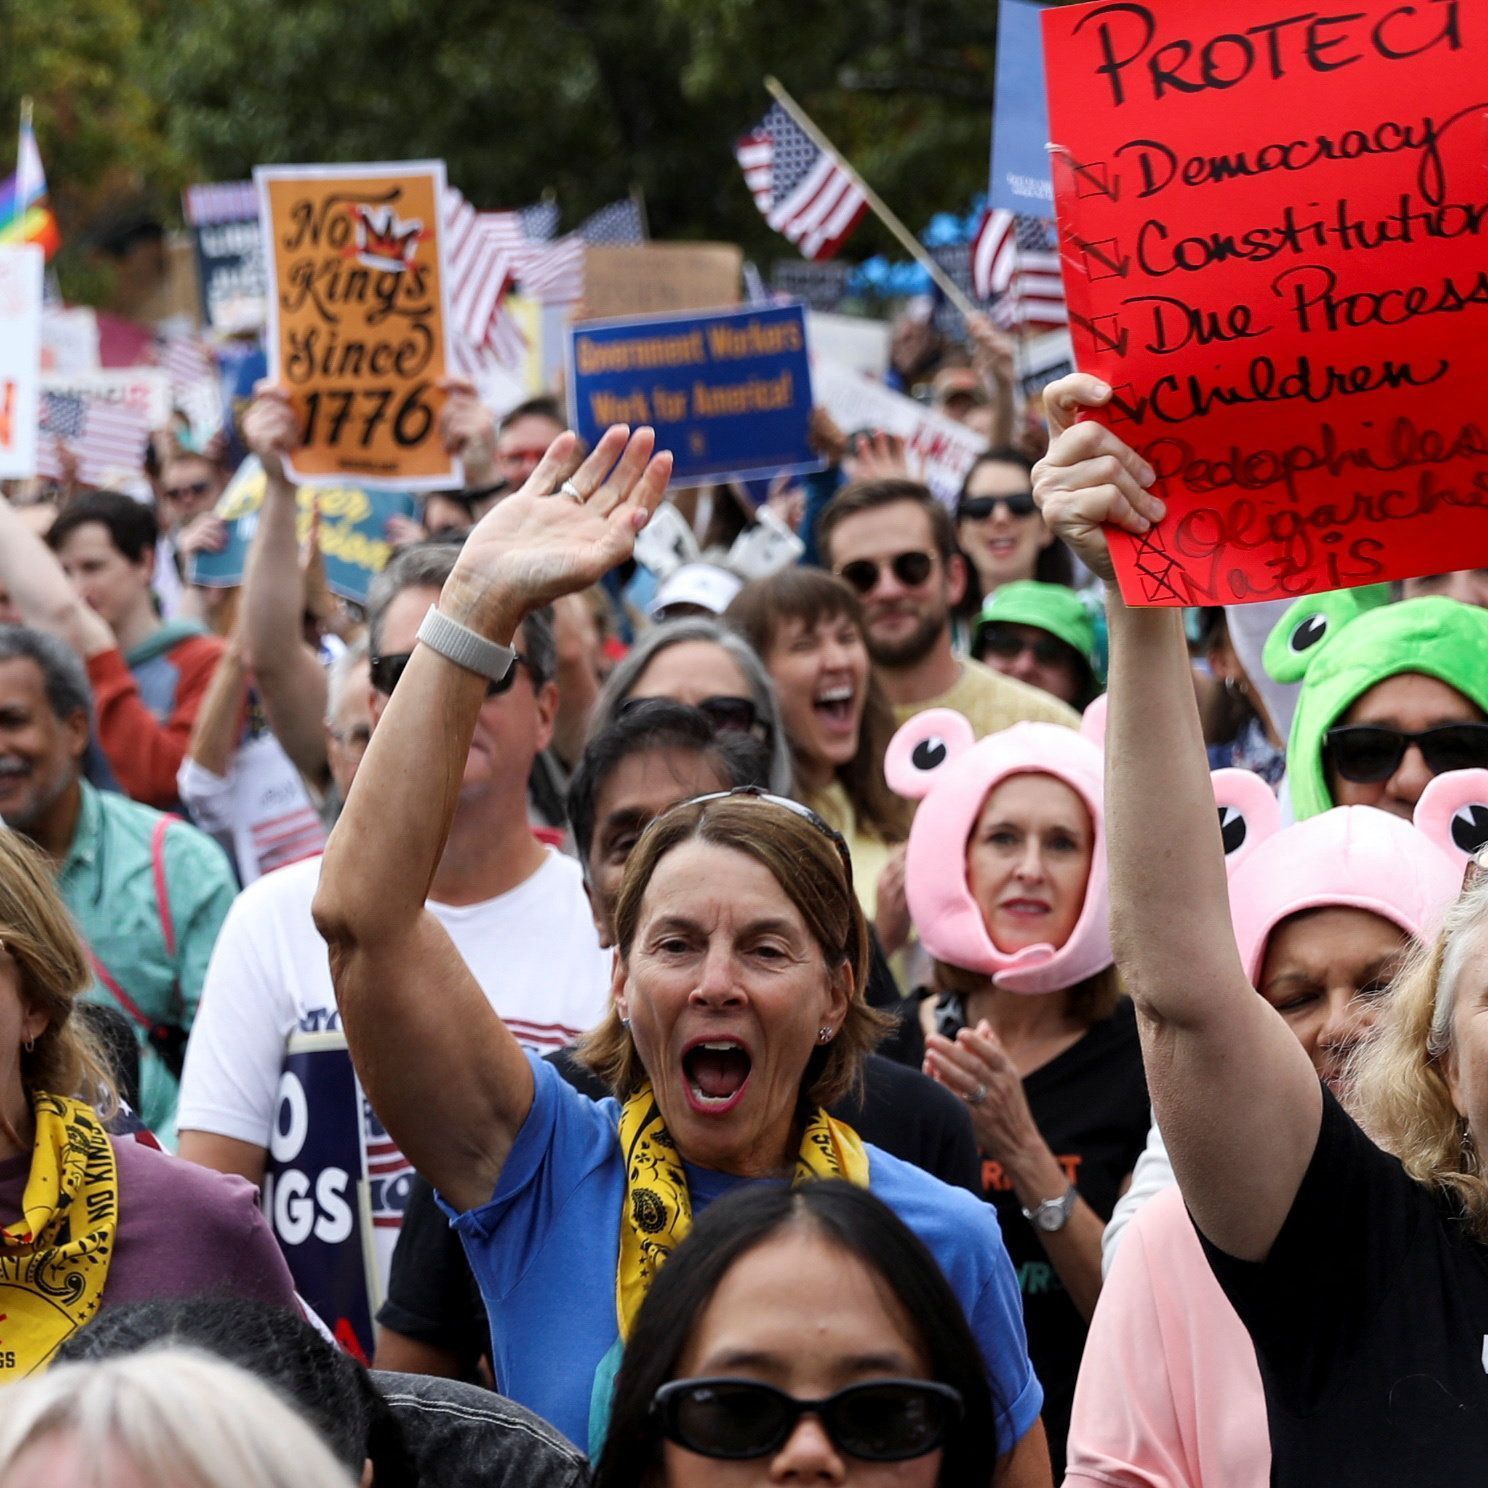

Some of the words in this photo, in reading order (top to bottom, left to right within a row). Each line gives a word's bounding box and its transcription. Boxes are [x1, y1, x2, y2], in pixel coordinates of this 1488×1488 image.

[1072, 0, 1464, 107] PROTECT
[283, 185, 402, 250] No
[281, 256, 433, 326] Kings
[1120, 294, 1274, 355] Due
[285, 321, 434, 384] Since
[300, 380, 433, 448] 1776
[1150, 355, 1450, 424] Children
[1178, 529, 1386, 606] Nazis
[270, 1070, 309, 1164] O
[86, 1190, 116, 1224] NO
